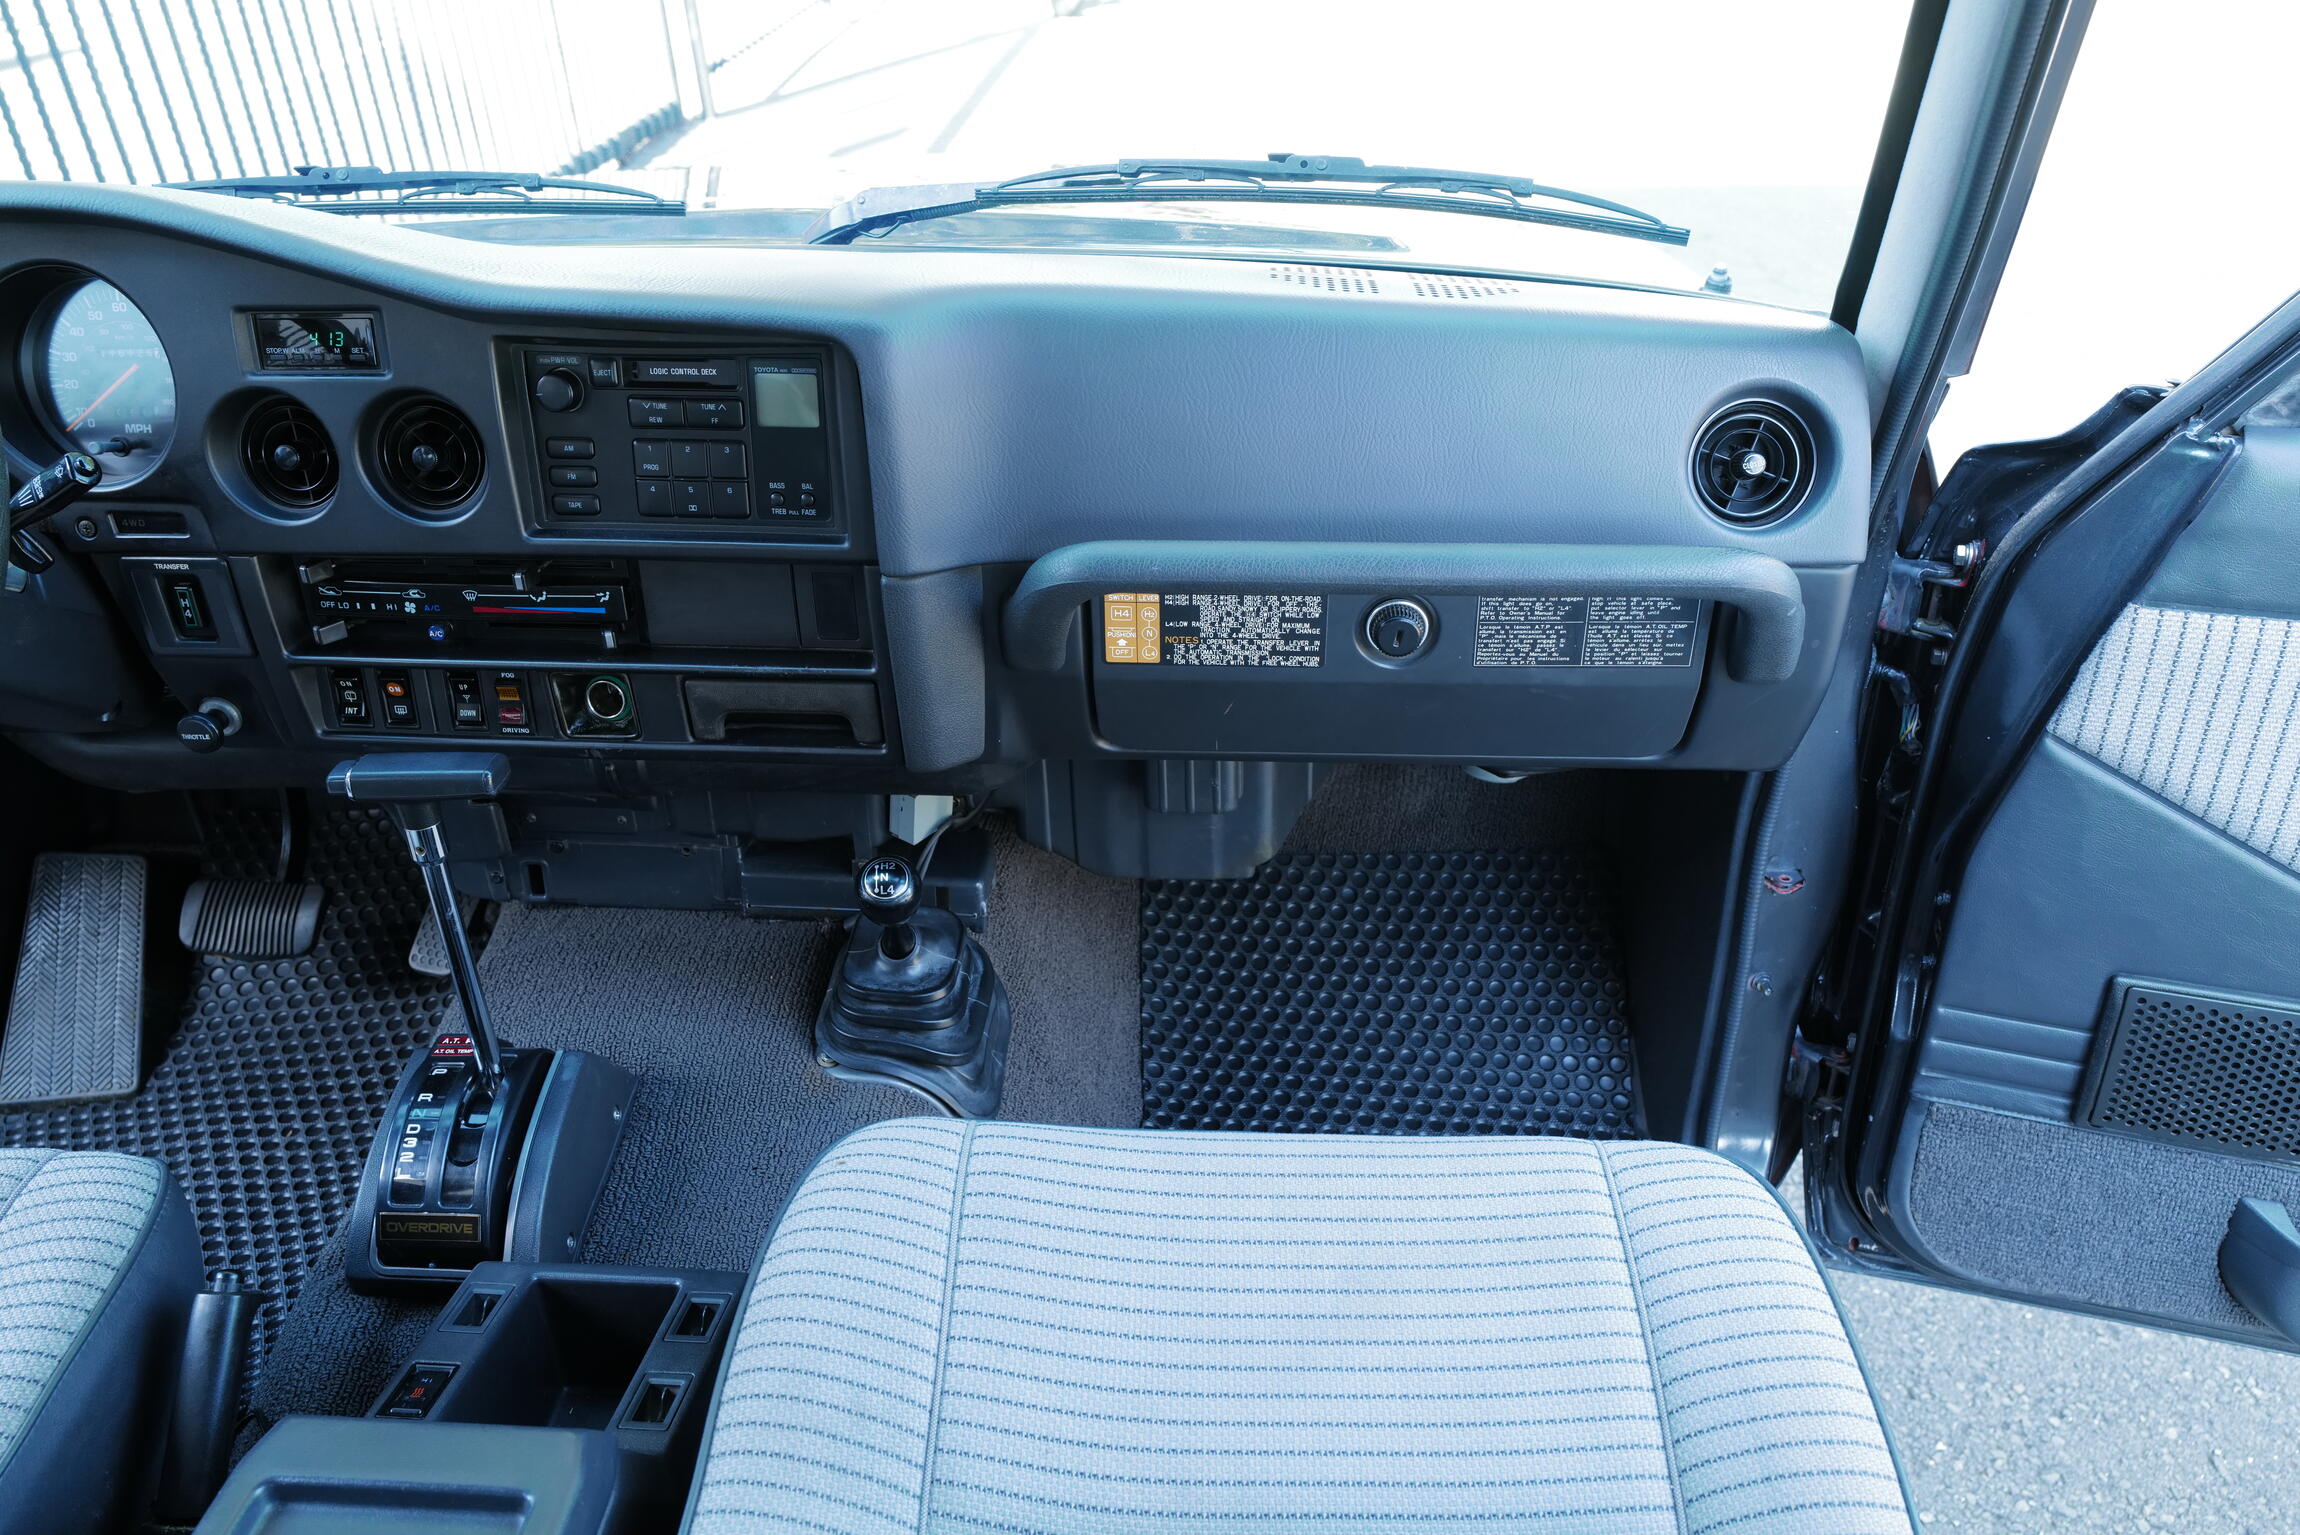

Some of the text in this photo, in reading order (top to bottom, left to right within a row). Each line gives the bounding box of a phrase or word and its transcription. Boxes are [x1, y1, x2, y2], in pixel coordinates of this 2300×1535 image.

[112, 302, 127, 312] 60
[88, 311, 103, 320] 50
[69, 327, 84, 336] 40
[62, 352, 77, 362] 30
[649, 367, 718, 376] LOGIC CONTROL DECK
[63, 379, 79, 389] 20
[652, 402, 668, 410] TUNE
[87, 418, 95, 427] 0
[125, 423, 152, 434] MPH
[801, 508, 817, 516] FADE
[386, 603, 398, 611] HI
[1114, 609, 1130, 617] H4
[1144, 610, 1155, 618] H2
[429, 630, 444, 638] A/C
[1165, 636, 1199, 644] NOTES
[1145, 649, 1156, 657] L4
[460, 709, 476, 717] DOWN
[880, 862, 896, 870] H2
[880, 873, 889, 882] N
[880, 885, 895, 895] L4
[417, 1093, 433, 1102] R
[411, 1108, 426, 1118] N
[406, 1124, 421, 1134] D
[402, 1137, 418, 1148] 3
[399, 1151, 415, 1162] 2
[396, 1167, 411, 1179] L
[386, 1222, 473, 1235] OVERDRIVE
